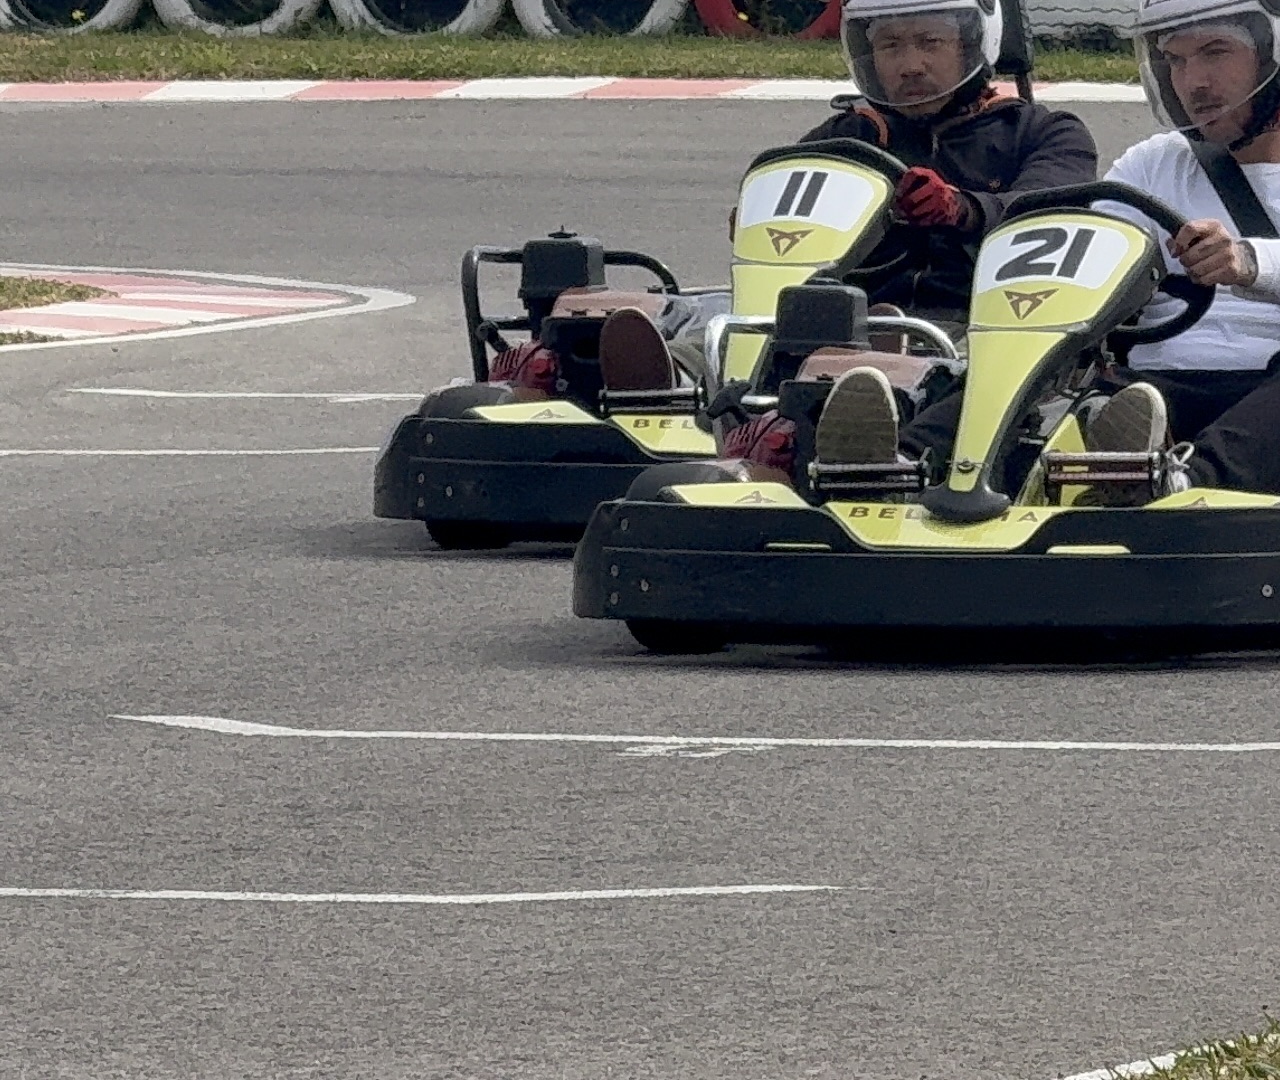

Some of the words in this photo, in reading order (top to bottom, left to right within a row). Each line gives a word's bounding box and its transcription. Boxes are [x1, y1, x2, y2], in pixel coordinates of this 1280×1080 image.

[773, 170, 828, 217] 11
[995, 227, 1096, 281] 21
[633, 418, 694, 429] BEL
